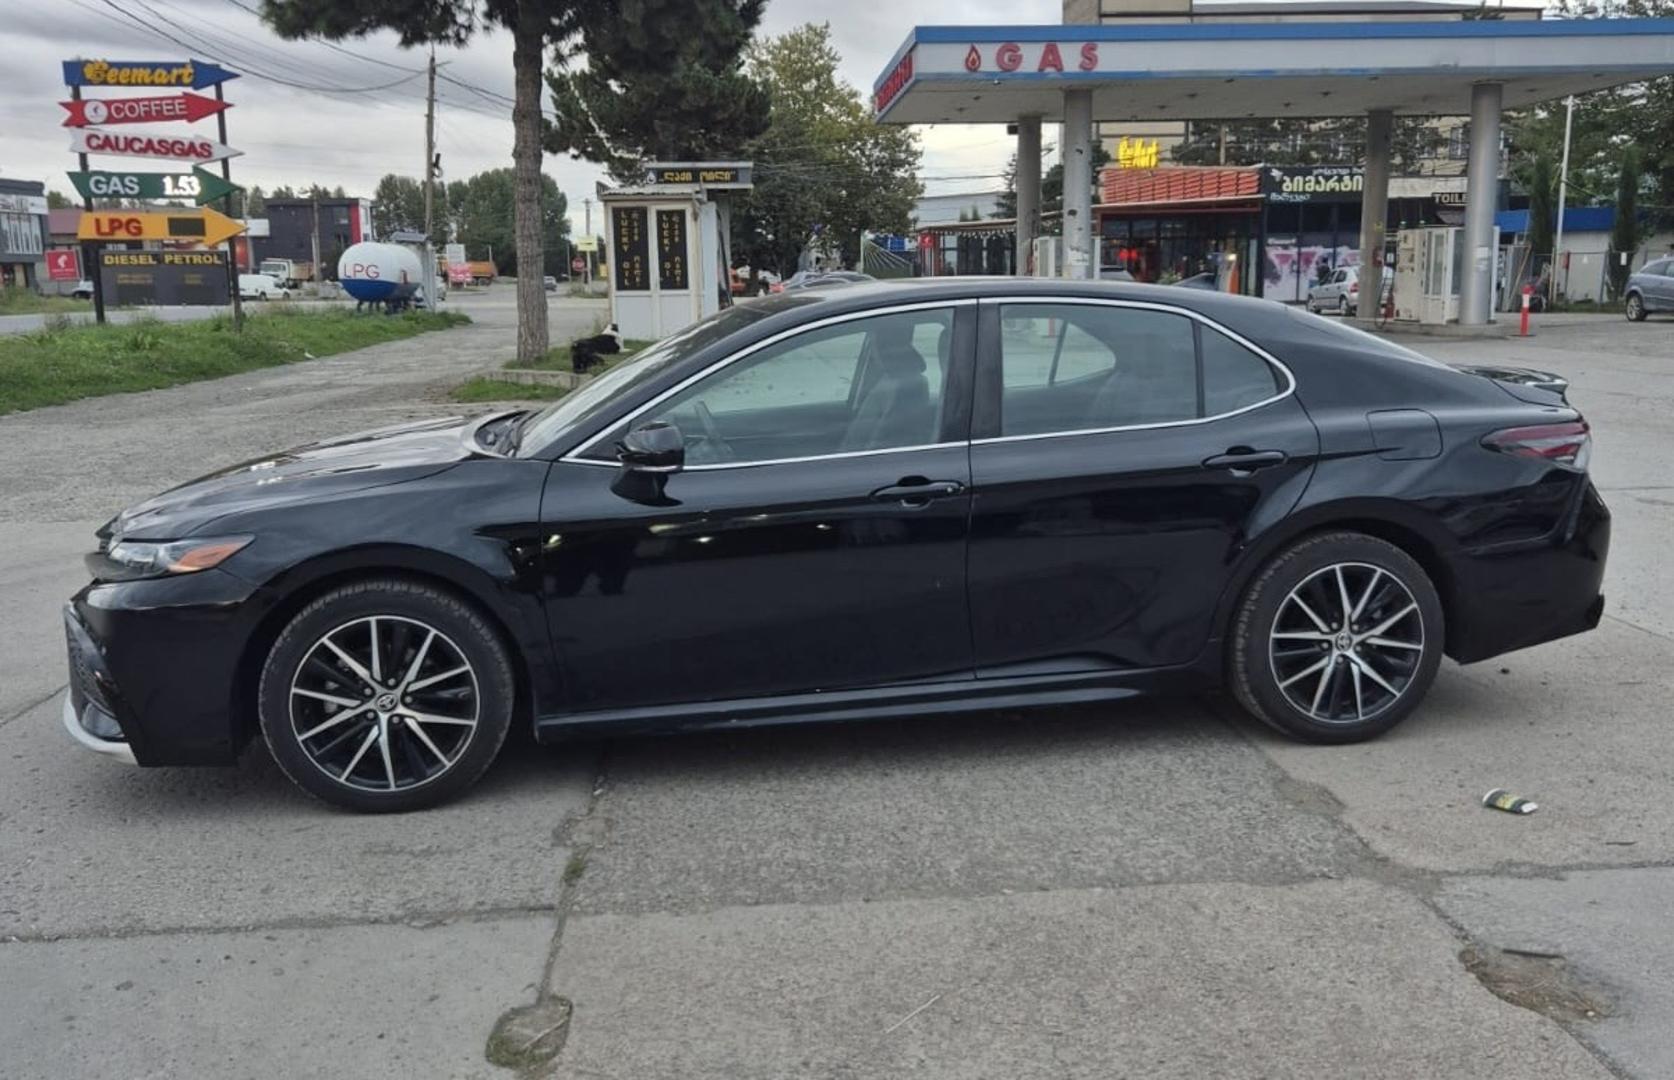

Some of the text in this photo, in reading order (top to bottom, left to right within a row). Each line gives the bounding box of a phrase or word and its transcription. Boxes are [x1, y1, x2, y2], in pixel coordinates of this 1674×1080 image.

[996, 42, 1098, 72] GAS
[110, 98, 189, 120] COFFEE
[86, 133, 213, 159] CAUCASGAS
[89, 175, 201, 196] GAS 1.53
[1282, 175, 1363, 192] ბიმარტი
[95, 217, 143, 237] LPG
[104, 254, 223, 265] DIESEL PETROL
[343, 264, 380, 278] LPG
